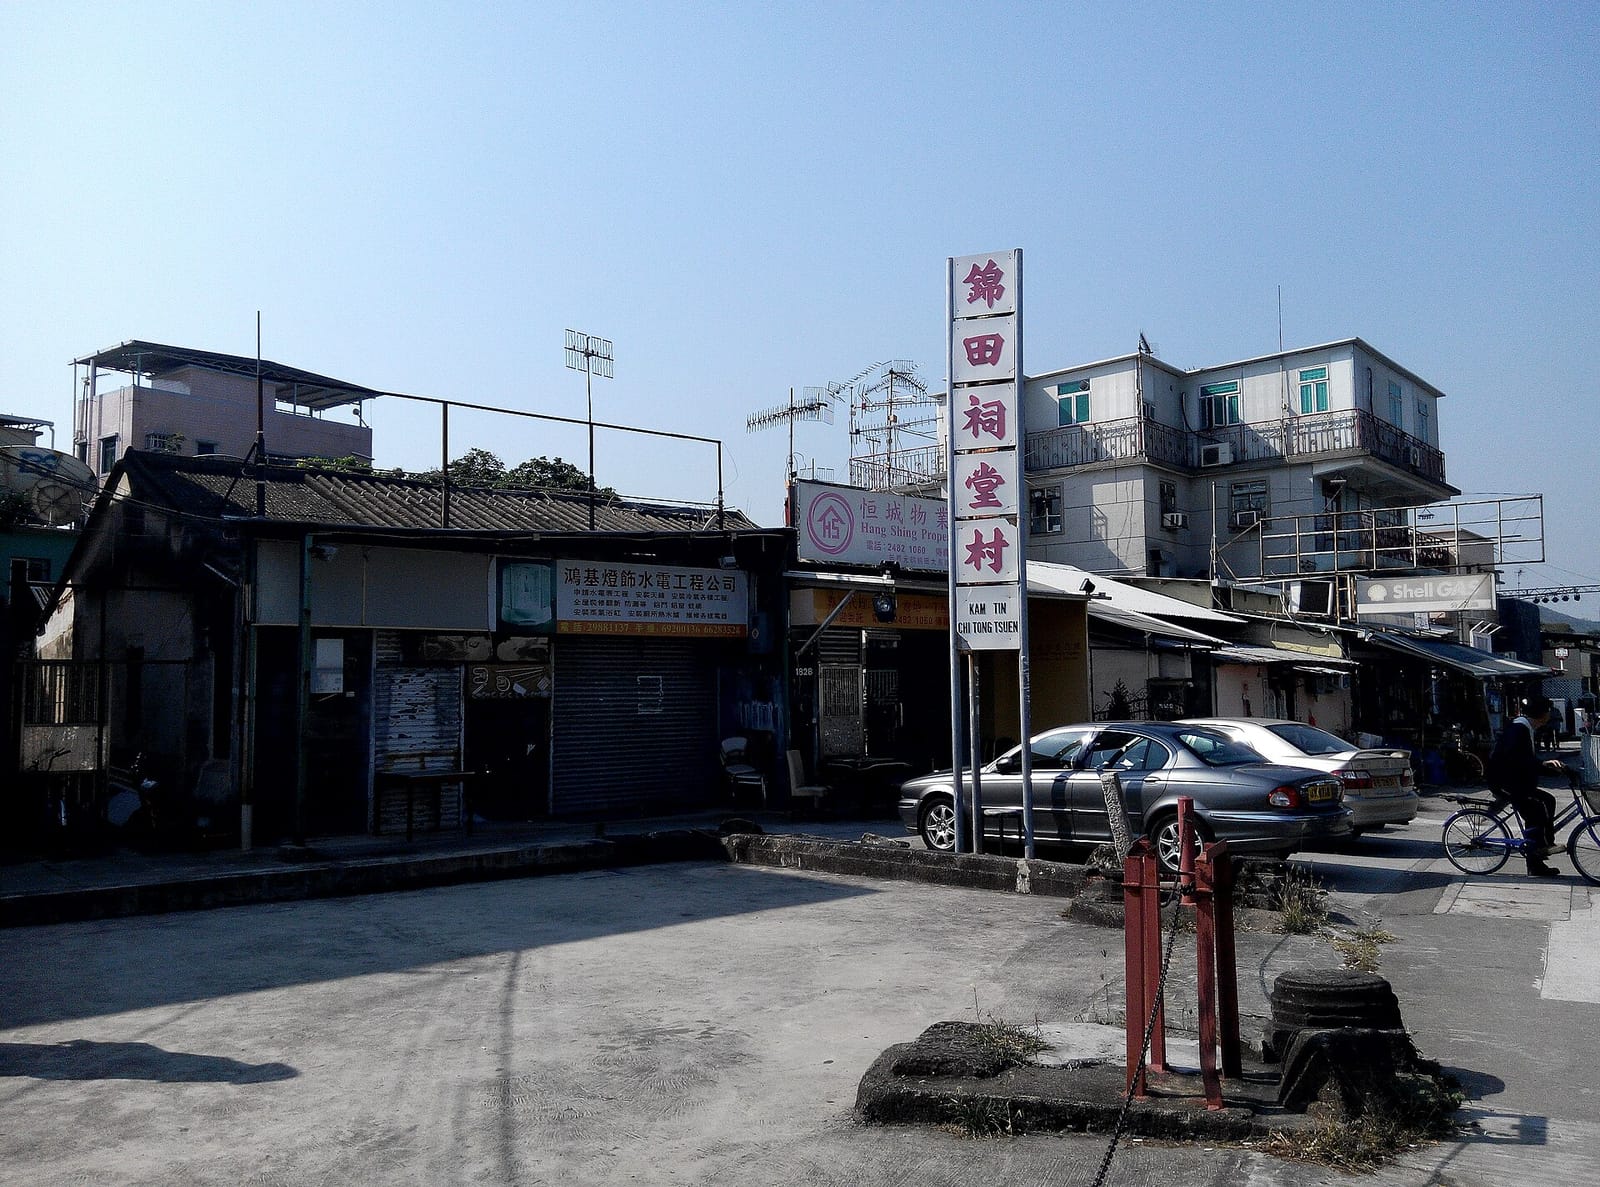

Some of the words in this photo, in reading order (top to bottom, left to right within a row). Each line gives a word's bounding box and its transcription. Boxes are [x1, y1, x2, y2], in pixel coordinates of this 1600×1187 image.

[962, 259, 1010, 574] 錦田祠堂村
[861, 521, 886, 538] Hang
[891, 525, 916, 541] Shing
[564, 567, 736, 592] 鴻基燈飾水電工程公司
[1393, 582, 1433, 599] Shell
[969, 603, 986, 615] KAM
[993, 602, 1007, 614] TIN
[958, 622, 971, 634] CHI
[973, 621, 993, 634] TONG
[994, 620, 1018, 633] TSUEN
